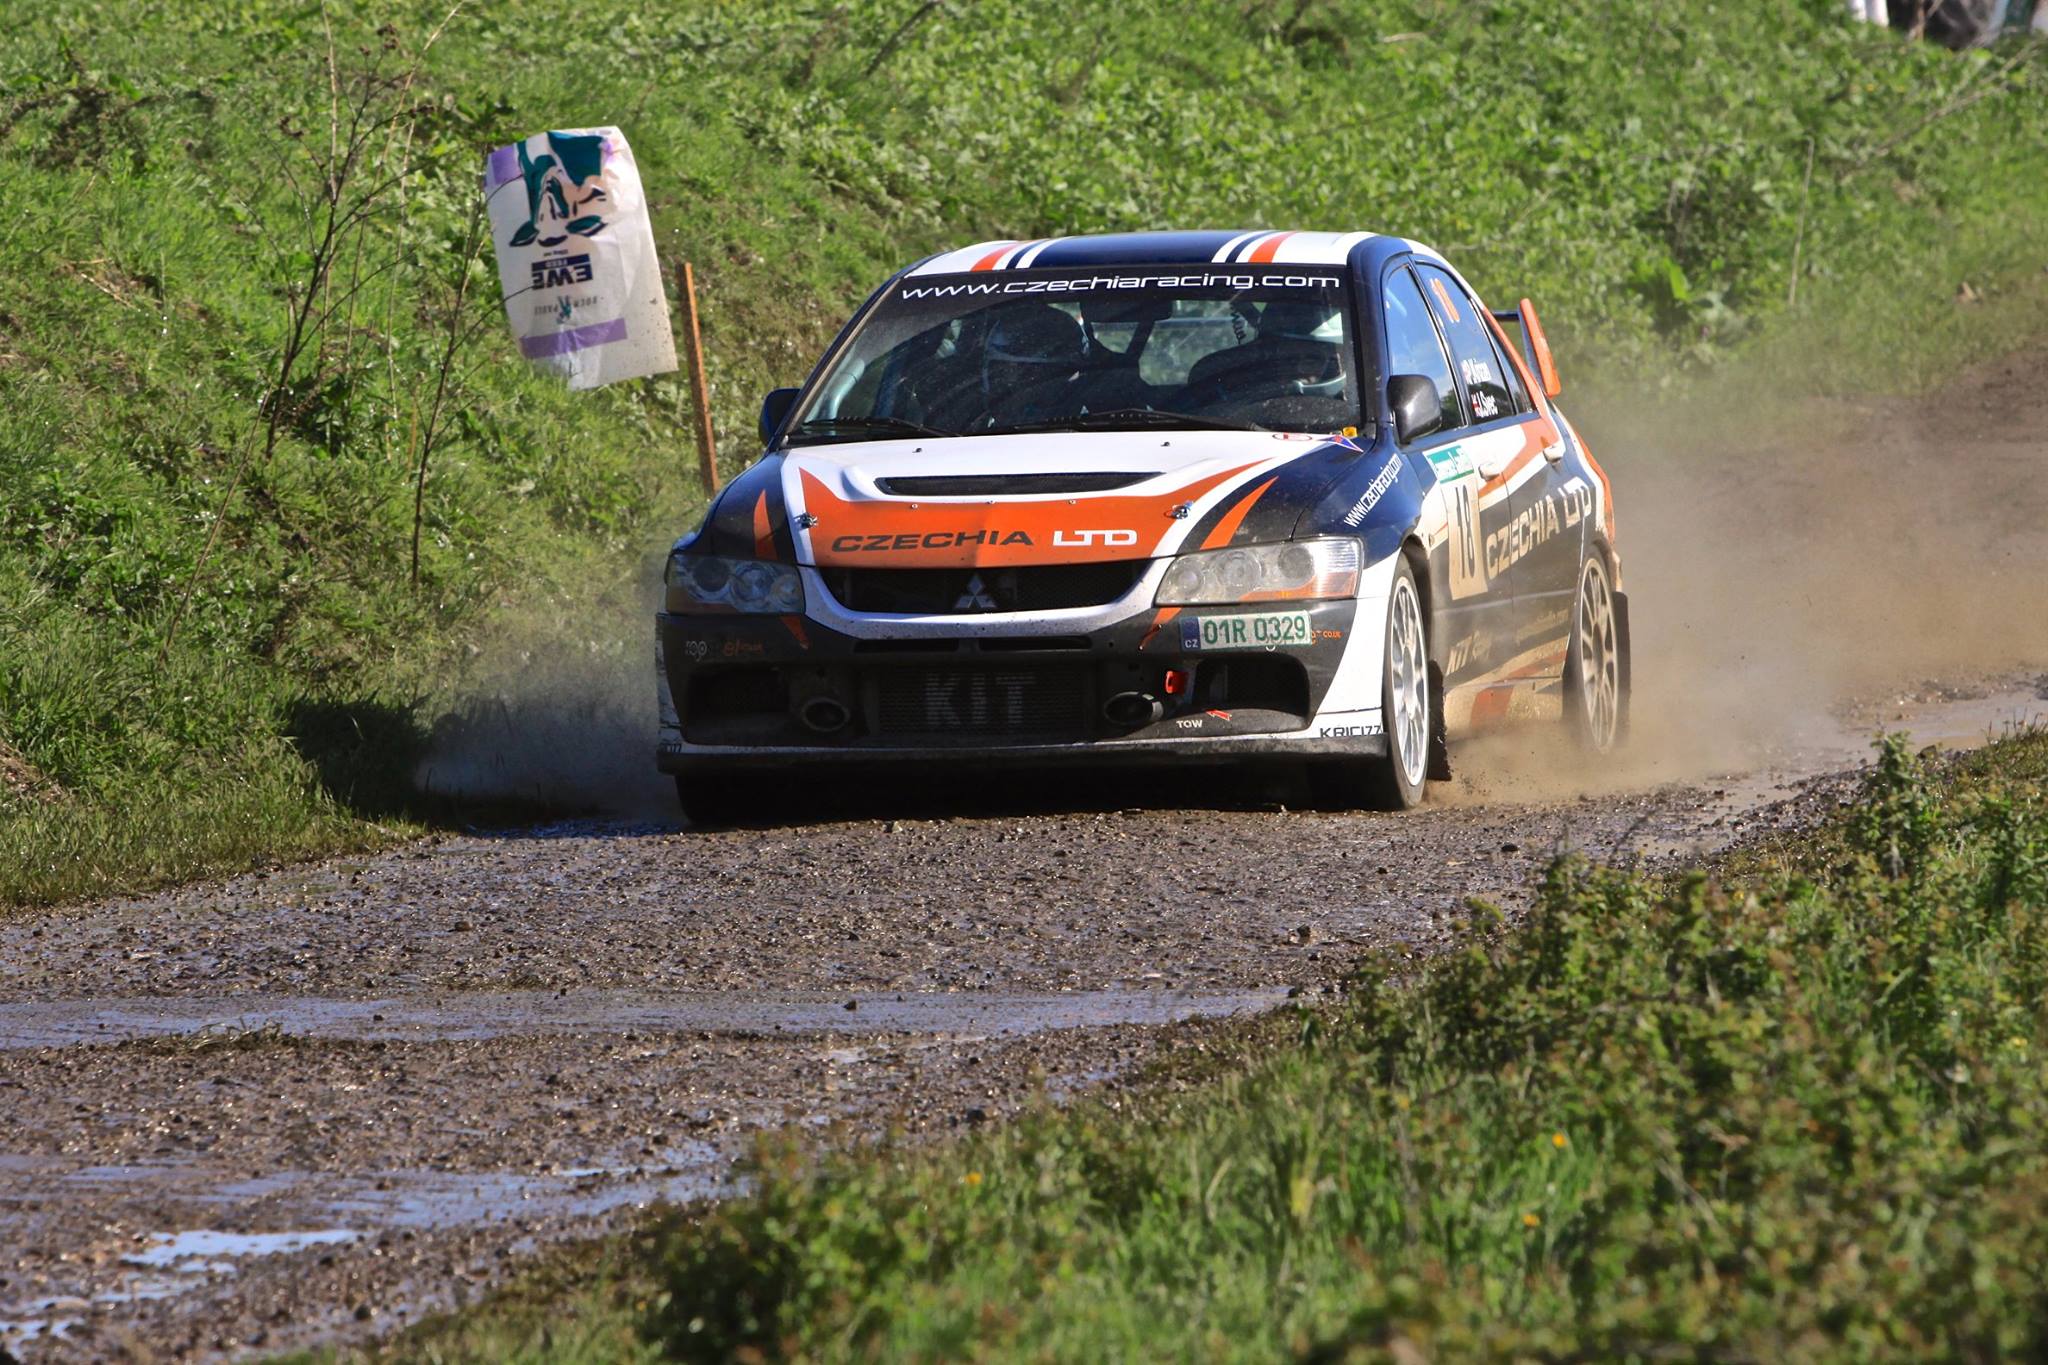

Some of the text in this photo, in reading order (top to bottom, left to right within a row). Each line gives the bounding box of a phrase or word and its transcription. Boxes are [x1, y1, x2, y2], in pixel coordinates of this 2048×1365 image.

[532, 263, 593, 290] EWE
[903, 273, 1340, 299] www.czechiaracing.com
[831, 529, 1138, 551] CZECHIA LTD
[1455, 484, 1476, 580] 18
[1486, 476, 1592, 580] CZECHIA LTD
[1203, 619, 1247, 644] 01R
[1254, 615, 1306, 642] 0329
[1184, 638, 1199, 648] CZ
[1175, 719, 1204, 729] TOW
